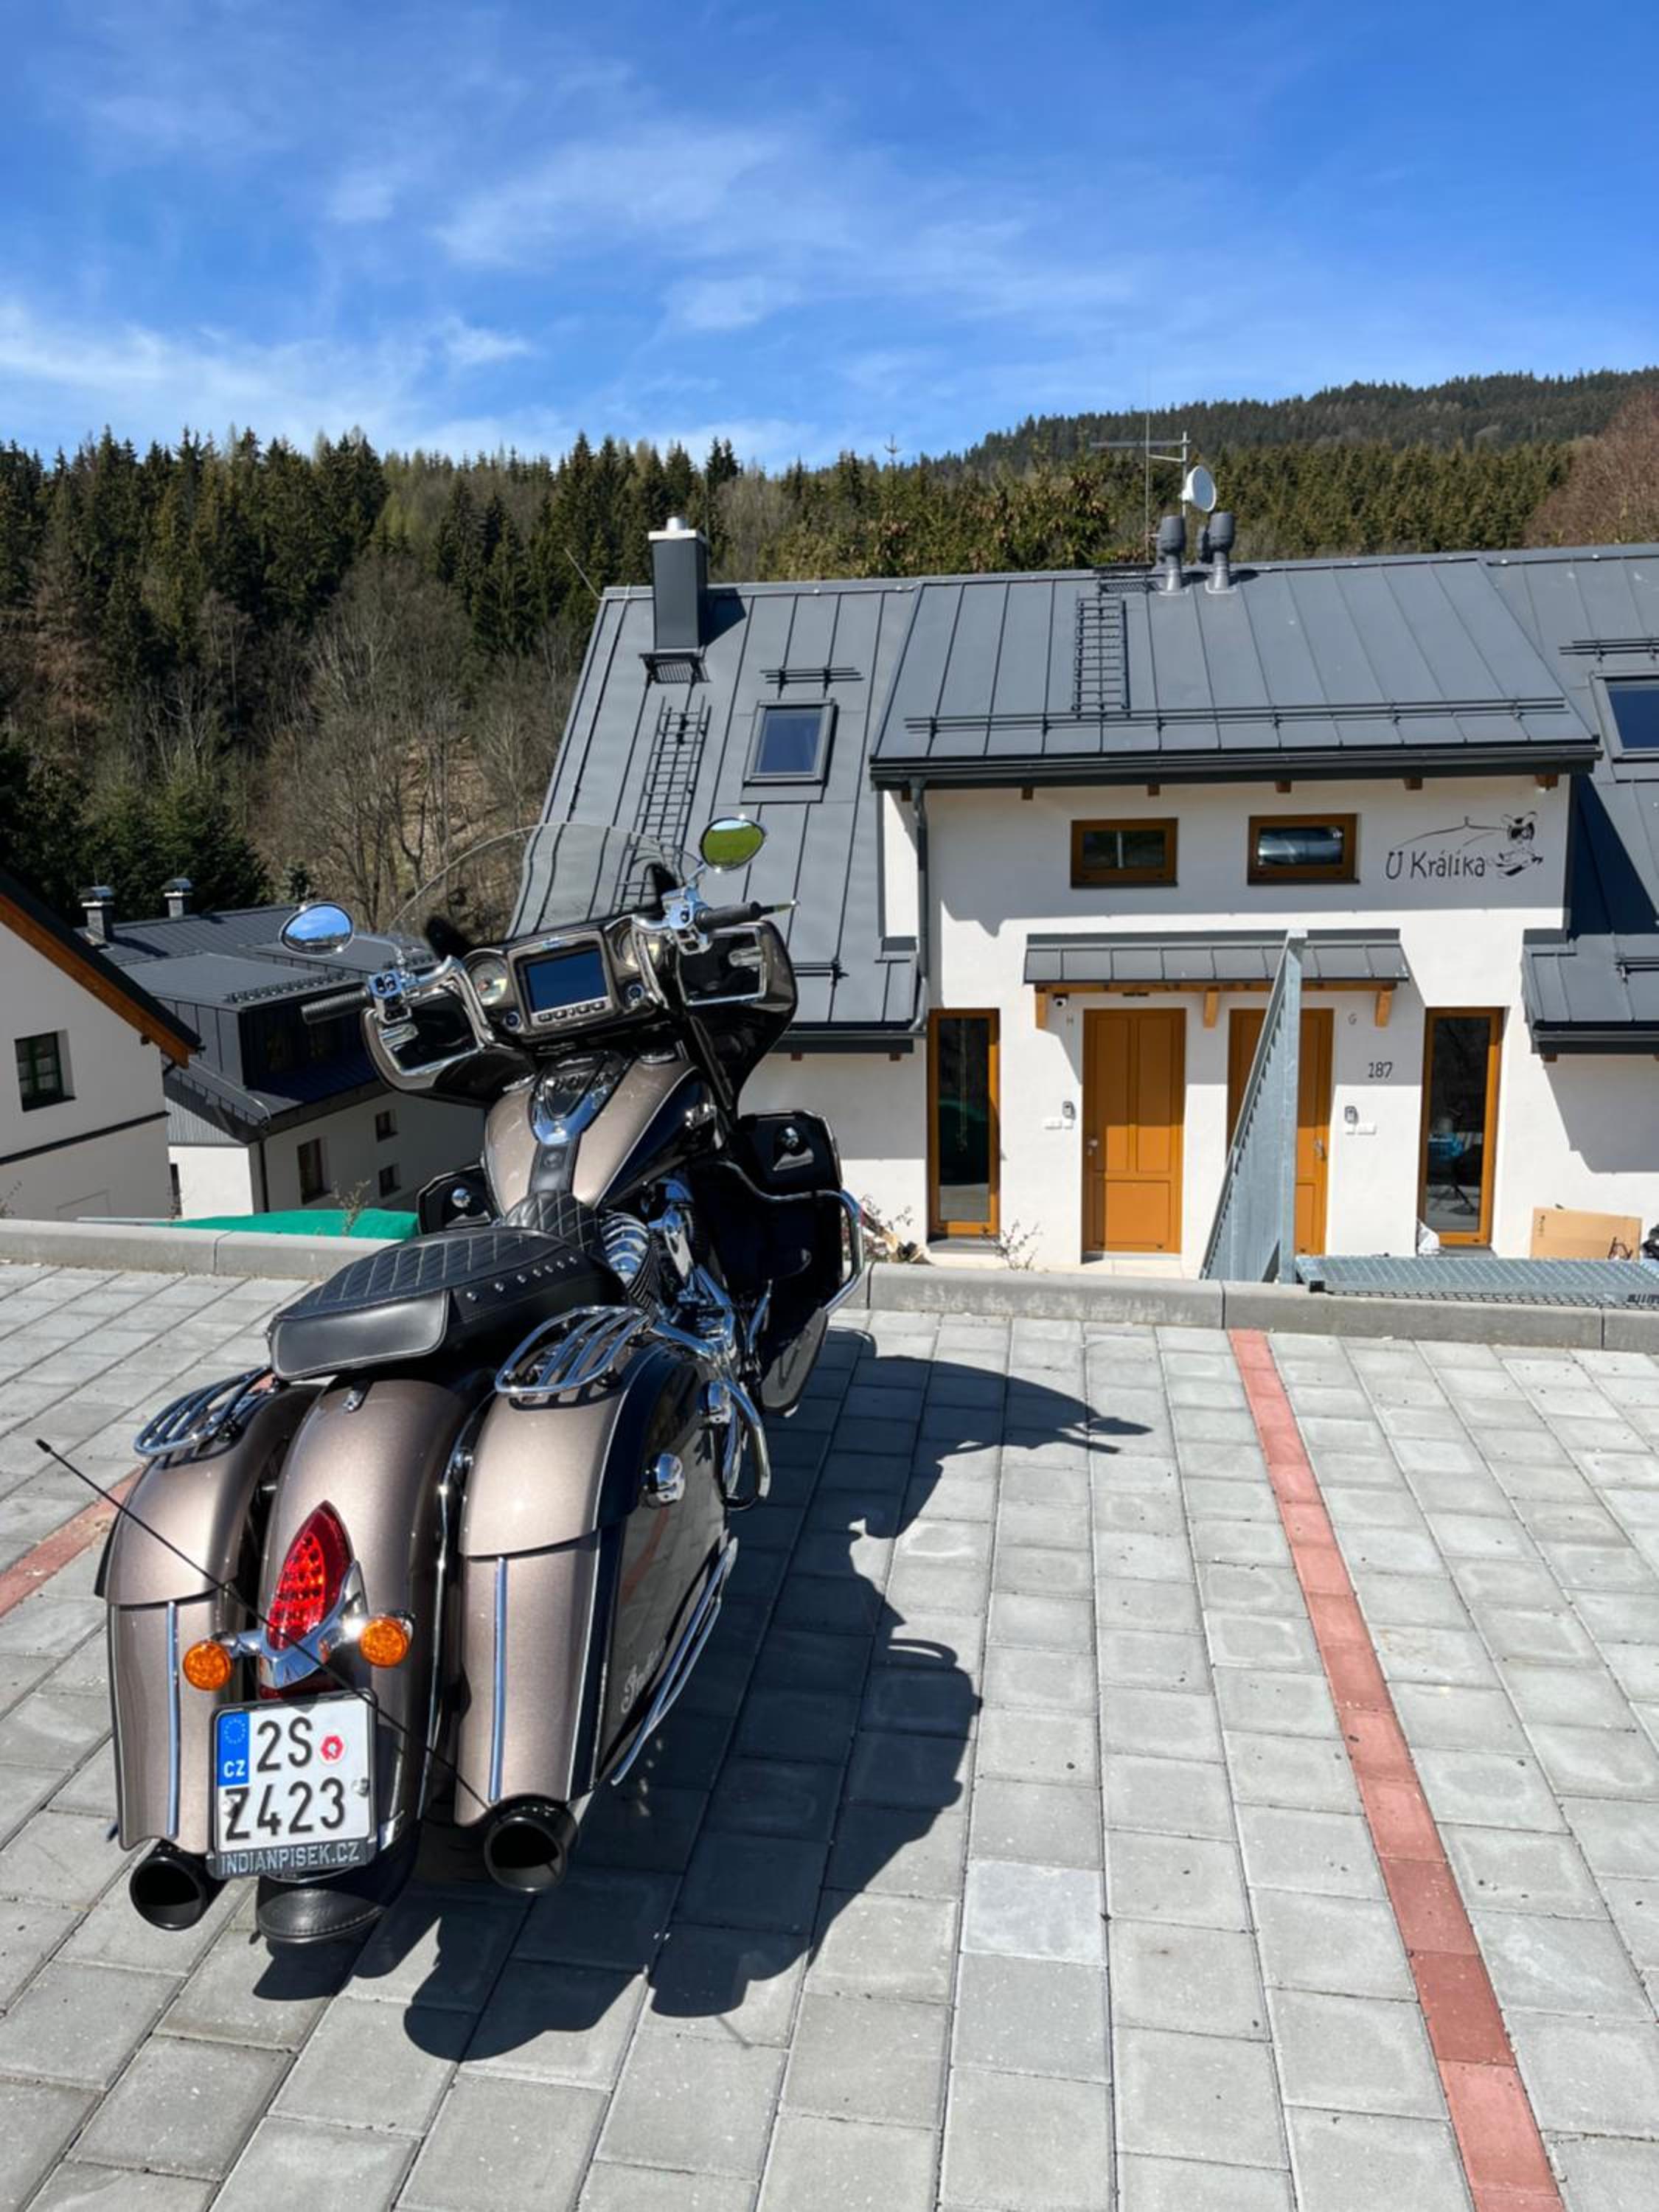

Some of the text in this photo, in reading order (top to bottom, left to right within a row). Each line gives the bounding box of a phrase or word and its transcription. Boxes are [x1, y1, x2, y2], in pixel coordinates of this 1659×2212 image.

[1385, 849, 1486, 880] U Králíka
[1368, 1062, 1393, 1078] 187
[257, 1716, 313, 1773] 2S
[223, 1760, 246, 1777] CZ
[225, 1777, 345, 1842] Z423
[222, 1842, 360, 1874] INDIANPISEK.CZ
